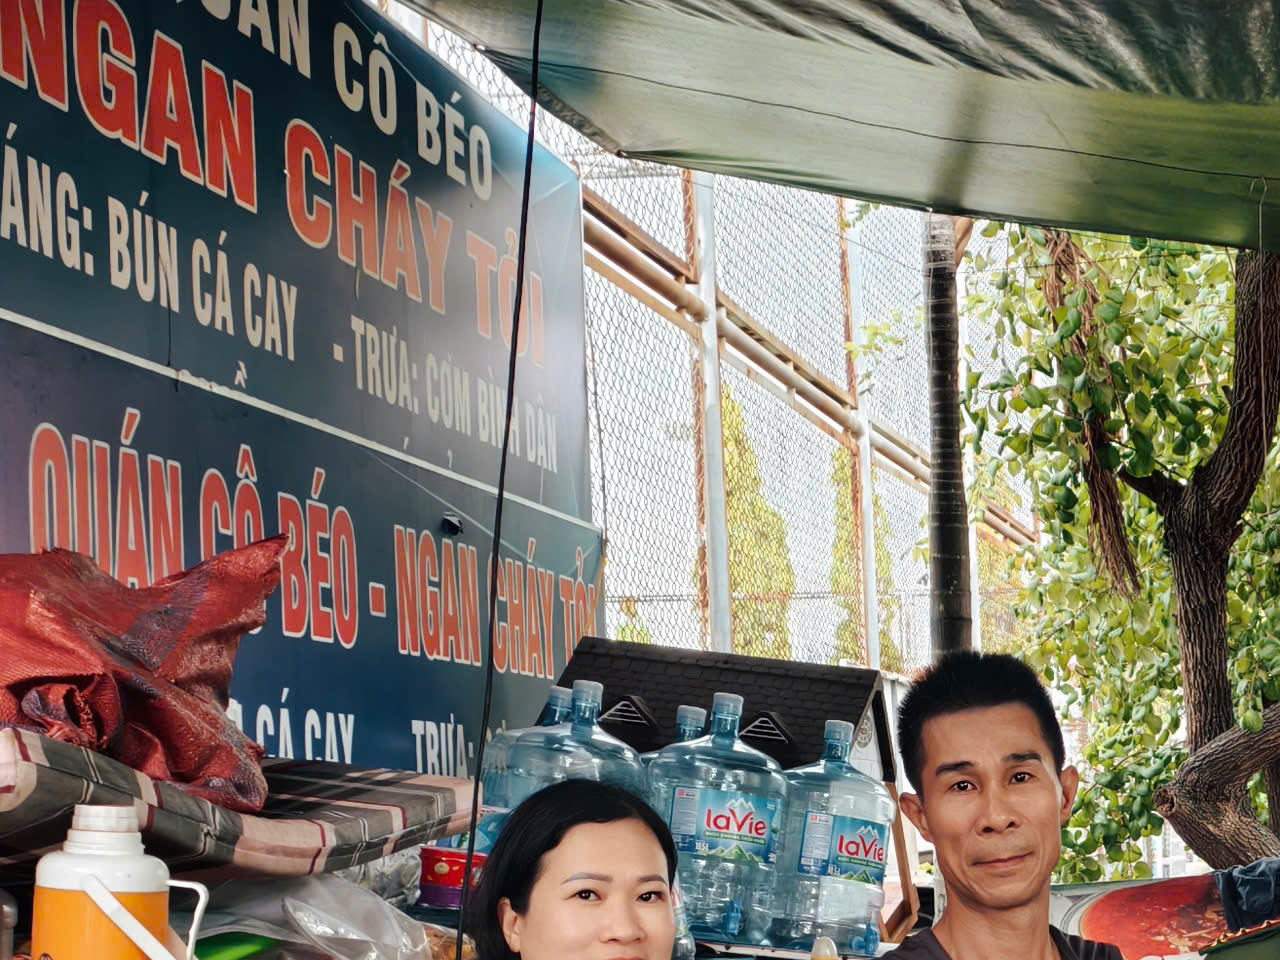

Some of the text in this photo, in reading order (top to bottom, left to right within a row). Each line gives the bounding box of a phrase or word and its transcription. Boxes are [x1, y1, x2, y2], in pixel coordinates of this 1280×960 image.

[0, 0, 258, 214] NGAN
[285, 118, 453, 315] CHÁY
[334, 22, 397, 136] CÔ
[416, 82, 492, 201] BÉO
[108, 190, 179, 314] BÚN
[192, 231, 235, 336] CÁ
[243, 263, 298, 361] CAY
[351, 314, 419, 415] TRƯA:
[425, 353, 472, 437] CƠM
[525, 393, 558, 474] DÂN
[277, 467, 358, 649] BÉO
[394, 523, 482, 667] NGAN
[487, 537, 555, 680] CHÁY
[256, 688, 295, 759] CÁ
[304, 709, 355, 765] CAY
[705, 808, 767, 837] laVie
[838, 834, 884, 862] laVie
